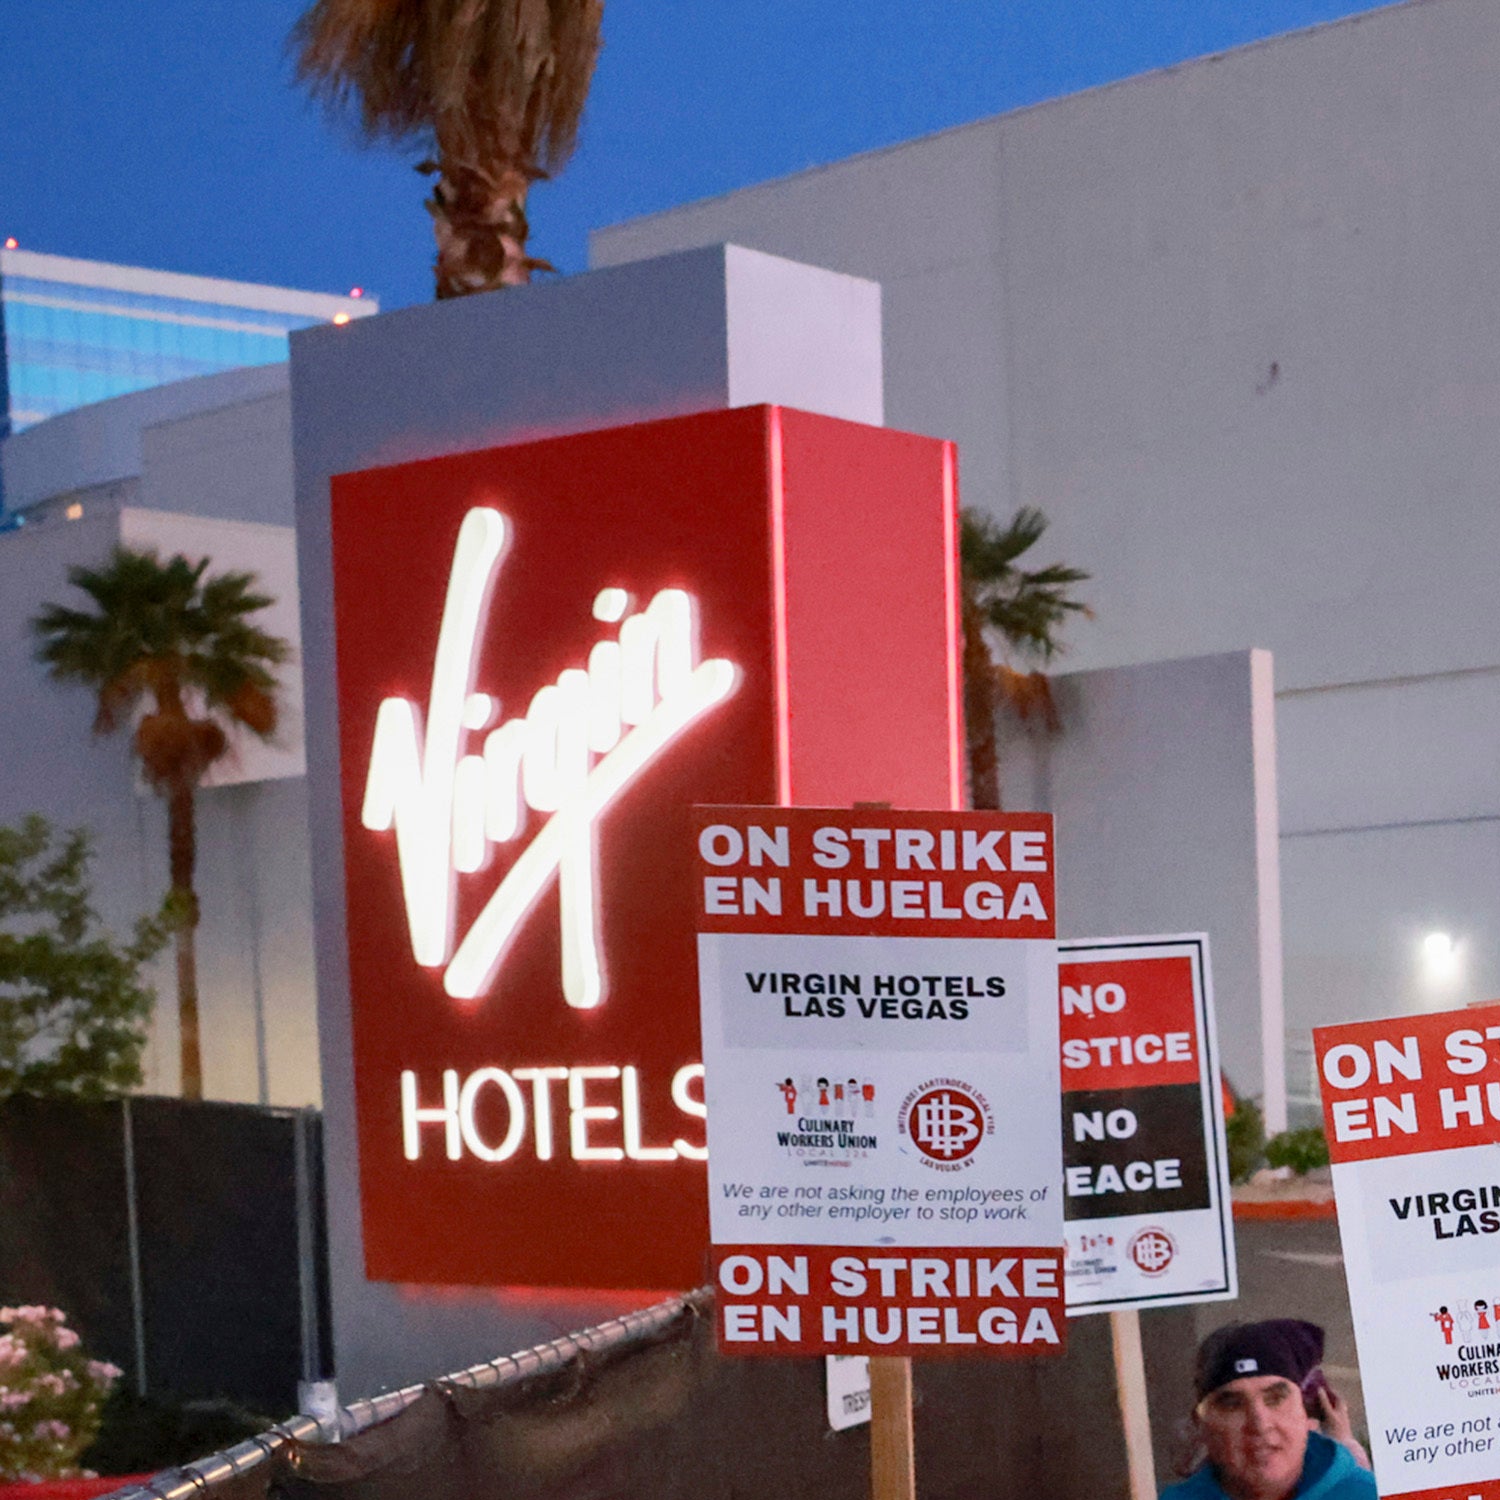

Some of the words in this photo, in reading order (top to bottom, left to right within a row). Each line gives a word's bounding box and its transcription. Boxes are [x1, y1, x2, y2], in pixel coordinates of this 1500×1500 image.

[363, 507, 740, 1008] Virgin
[699, 825, 790, 867] ON
[812, 827, 1047, 872] STRIKE
[704, 876, 782, 916] EN
[804, 879, 1048, 920] HUELGA
[745, 973, 861, 995] VIRGIN
[874, 976, 1006, 998] HOTELS
[1061, 983, 1126, 1015] NO
[784, 997, 845, 1018] LAS
[857, 999, 968, 1020] VEGAS
[1062, 1032, 1192, 1068] STICE
[1323, 1036, 1422, 1089] ON
[399, 1065, 708, 1163] HOTELS
[798, 1117, 854, 1133] CULINARY
[1073, 1109, 1138, 1141] NO
[1332, 1092, 1419, 1143] EN
[777, 1132, 834, 1149] WORKERS
[838, 1133, 877, 1149] UNION
[723, 1183, 753, 1199] We
[760, 1185, 788, 1199] are
[795, 1185, 822, 1199] not
[829, 1185, 884, 1205] asking
[891, 1185, 918, 1200] the
[925, 1186, 1024, 1205] employees
[1030, 1185, 1048, 1201] of
[1066, 1159, 1182, 1197] EACE
[739, 1204, 770, 1220] any
[777, 1202, 821, 1218] other
[829, 1204, 909, 1221] employer
[917, 1205, 933, 1219] to
[940, 1205, 977, 1221] stop
[1434, 1210, 1500, 1239] LAS
[719, 1255, 809, 1295] ON
[830, 1257, 1059, 1298] STRIKE
[723, 1305, 800, 1342] EN
[822, 1306, 1060, 1344] HUELGA
[1437, 1358, 1499, 1381] WORKERS
[1385, 1426, 1417, 1446] We
[1424, 1422, 1455, 1441] are
[1461, 1417, 1491, 1435] not
[1403, 1445, 1439, 1464] any
[1445, 1436, 1493, 1457] other
